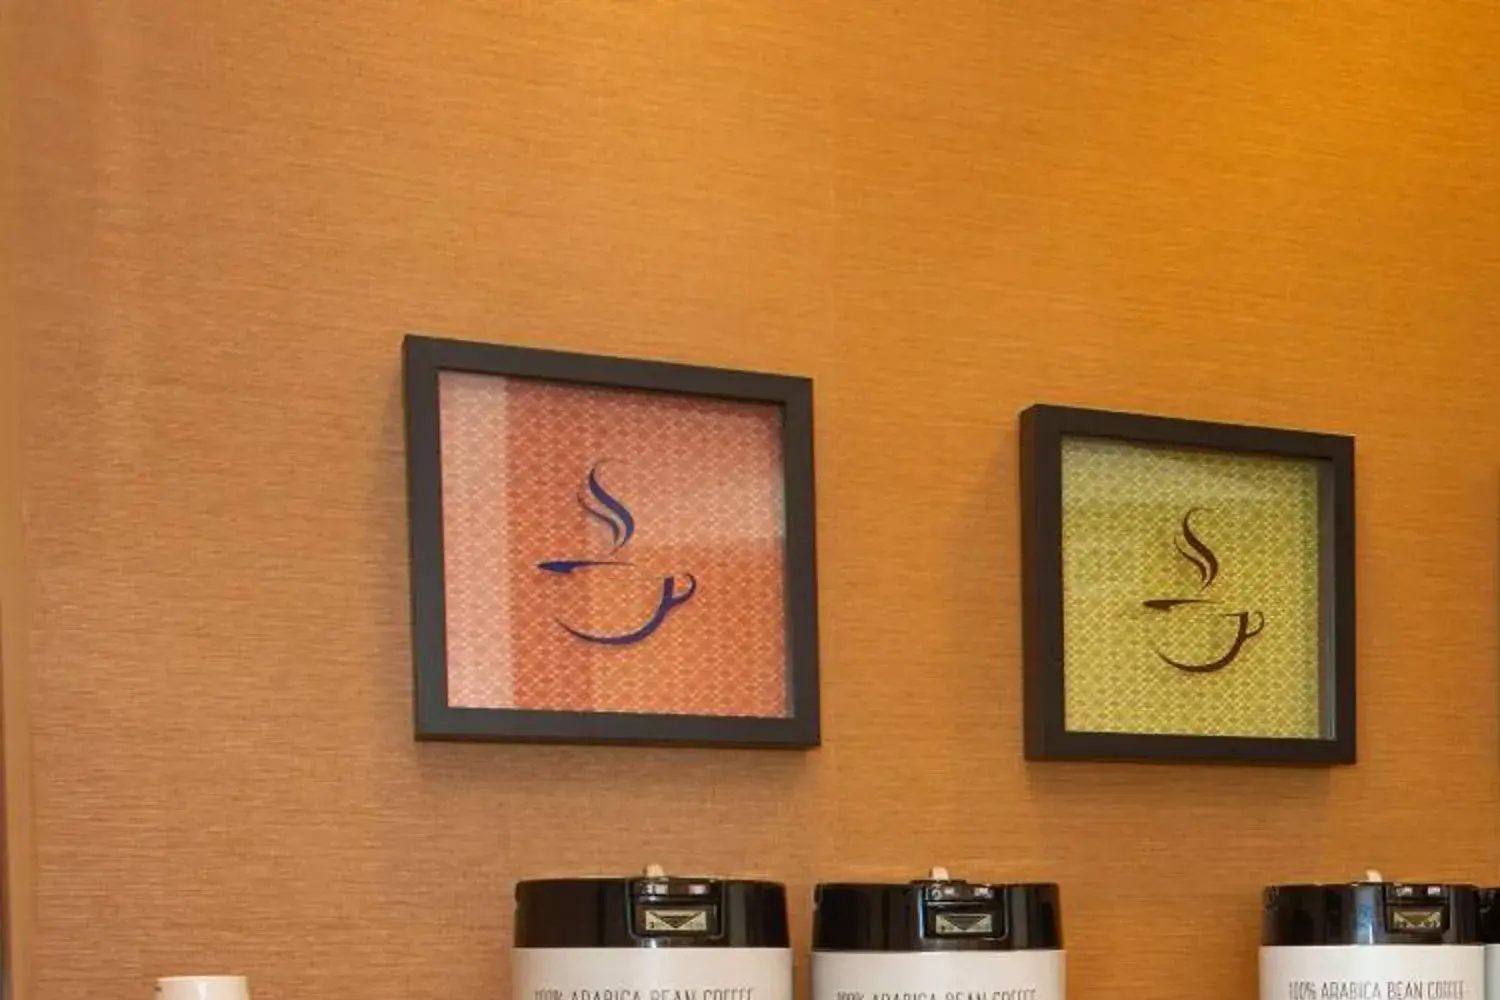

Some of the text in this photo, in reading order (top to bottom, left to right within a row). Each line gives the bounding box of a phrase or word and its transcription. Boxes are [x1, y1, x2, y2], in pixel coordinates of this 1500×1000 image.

[1289, 980, 1464, 1000] 100% ARABICA BEAN COFFEE
